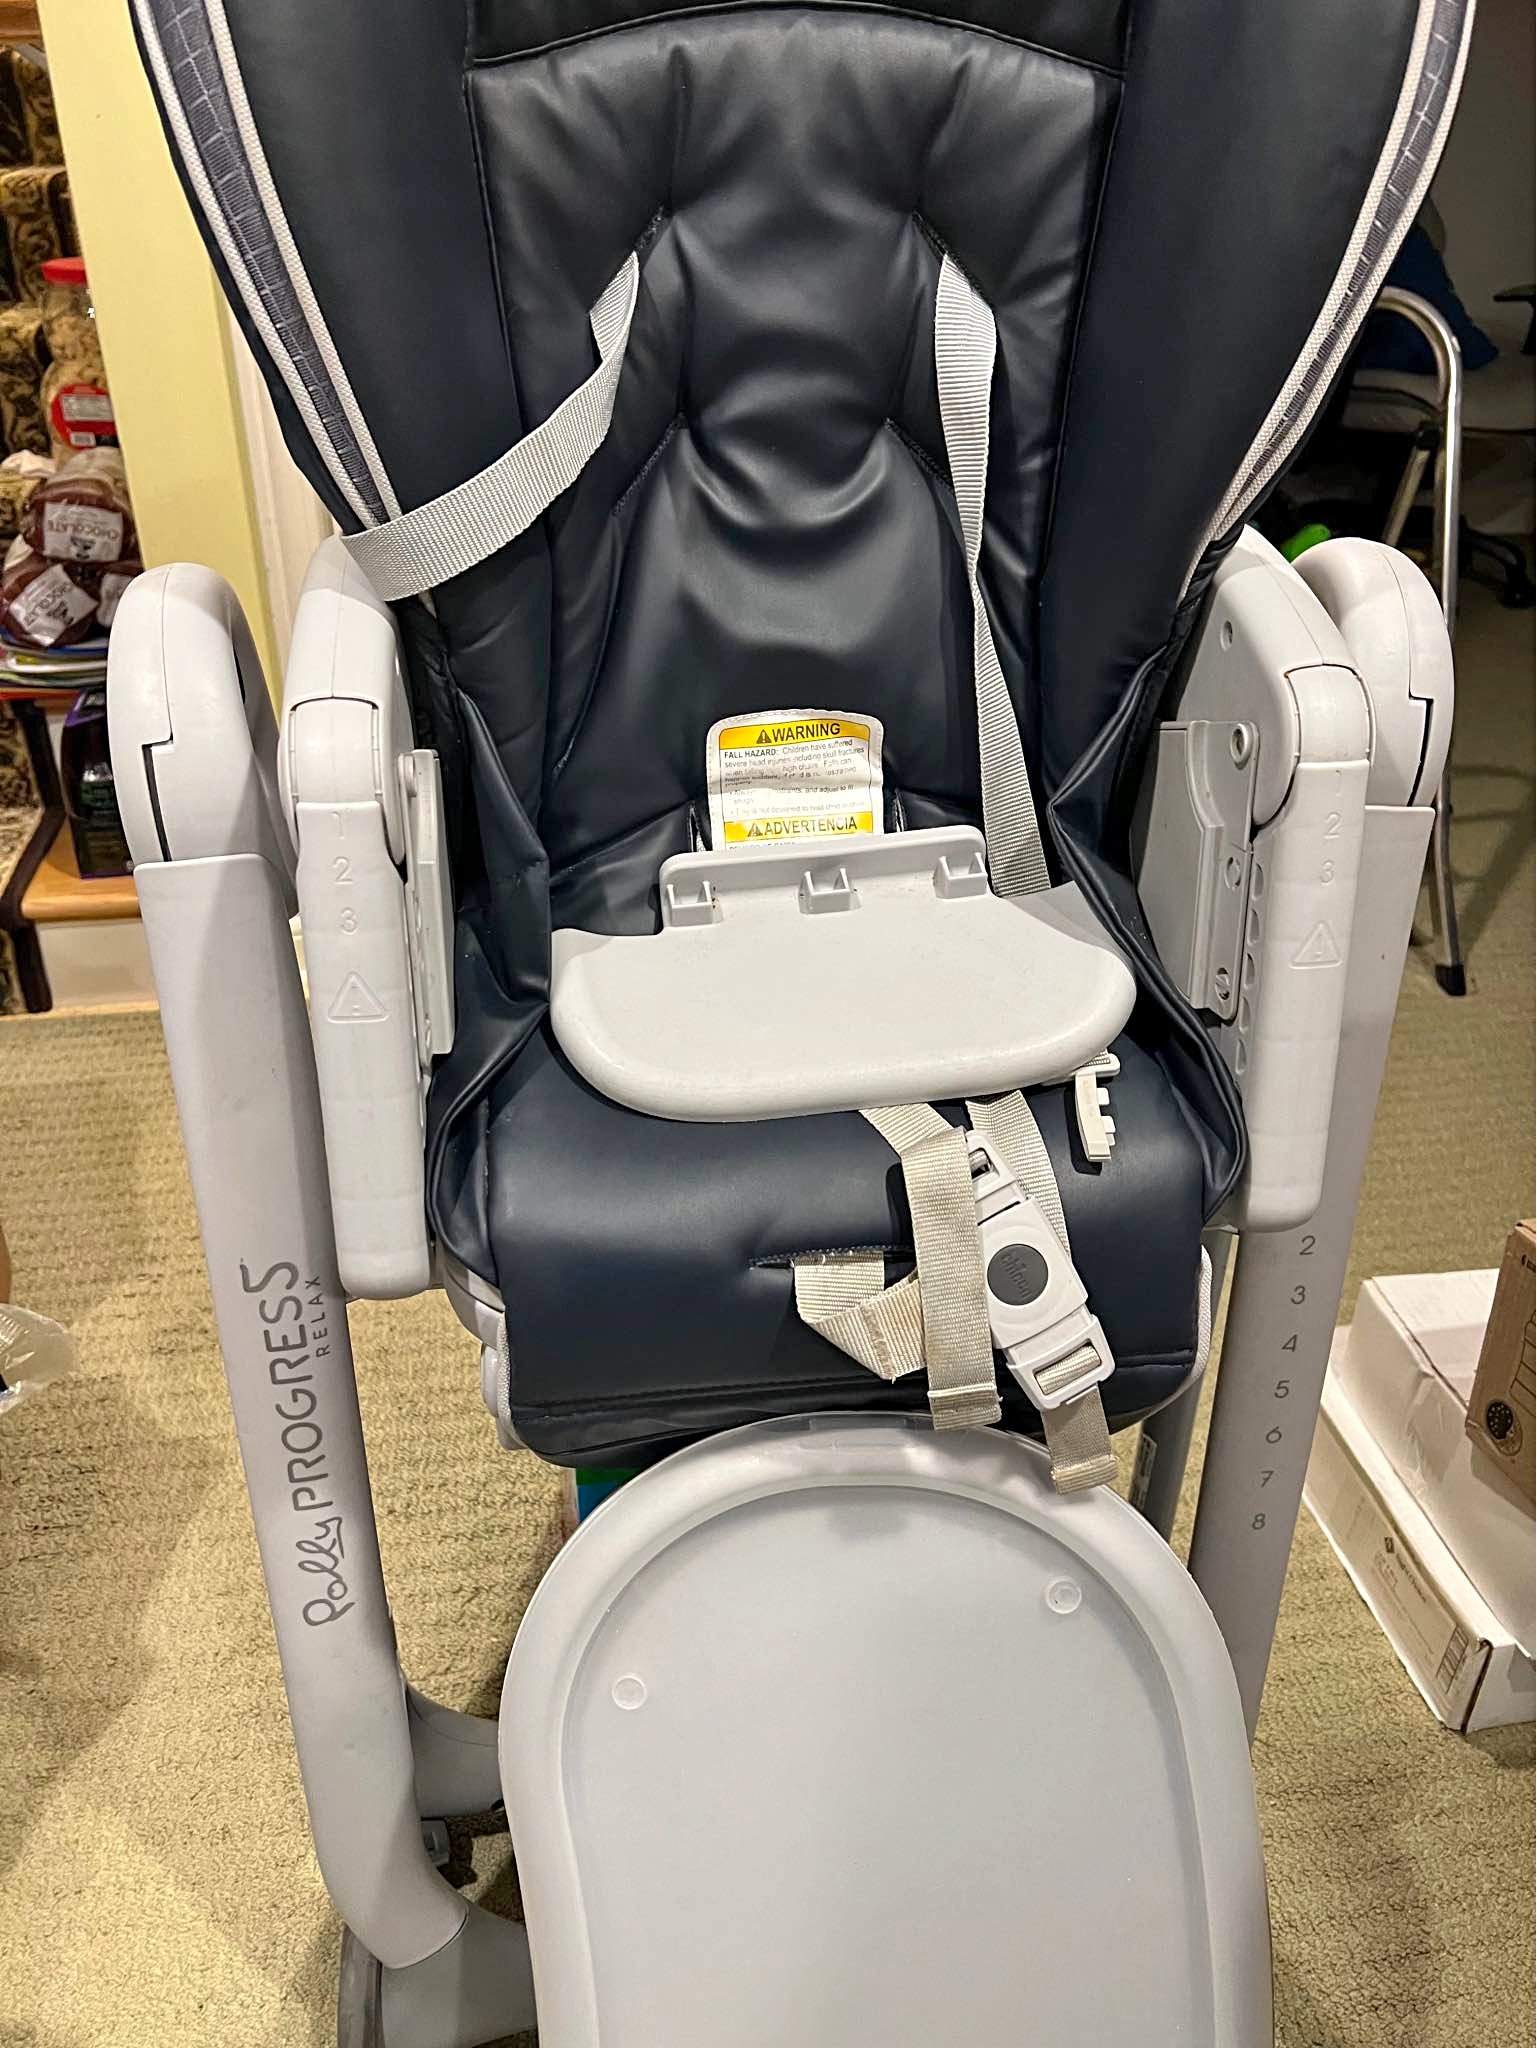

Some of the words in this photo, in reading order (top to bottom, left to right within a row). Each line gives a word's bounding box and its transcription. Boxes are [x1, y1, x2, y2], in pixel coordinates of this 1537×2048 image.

[772, 722, 841, 743] WARNING
[724, 751, 743, 759] FALL
[782, 745, 810, 755] Children
[810, 743, 827, 752] have
[827, 739, 853, 749] suffered
[822, 749, 837, 759] skull
[764, 815, 858, 836] ADVERTENCIA
[1323, 812, 1342, 840] 2
[332, 856, 354, 885] 2
[1319, 858, 1336, 886] 3
[339, 906, 359, 936] 3
[1299, 1235, 1316, 1256] 2
[1290, 1285, 1306, 1305] 3
[304, 1274, 331, 1358] RELAX
[1281, 1333, 1299, 1353] 4
[239, 1258, 334, 1512] PROGRESS
[1274, 1379, 1290, 1399] 5
[1265, 1426, 1283, 1444] 6
[1259, 1470, 1275, 1488] 7
[1251, 1512, 1267, 1531] 8
[295, 1515, 355, 1627] Polly
